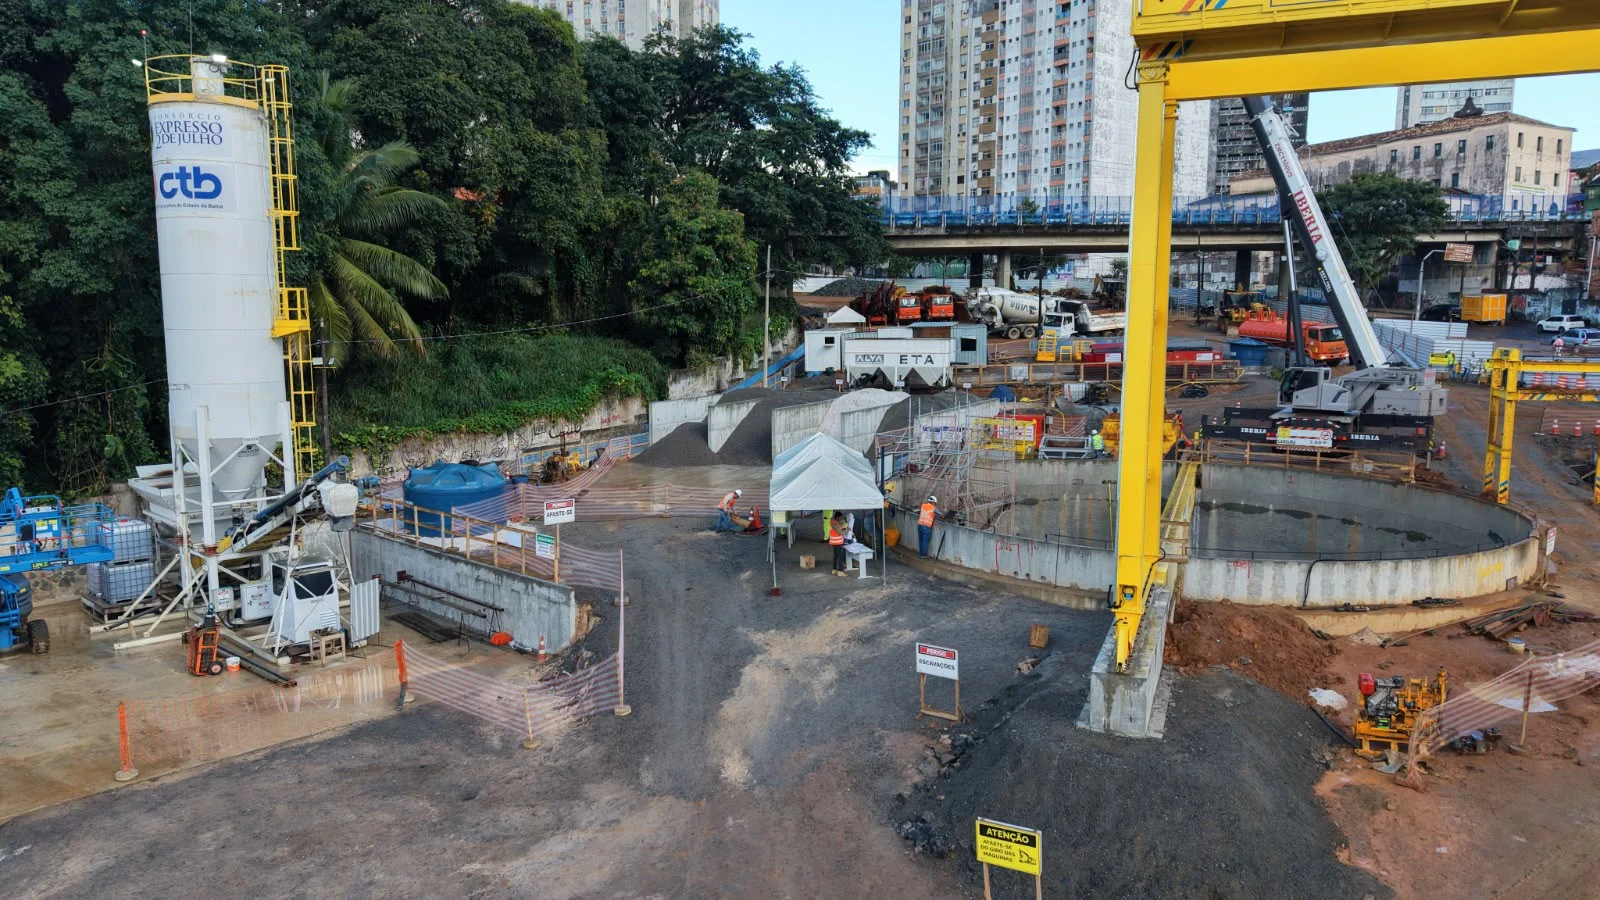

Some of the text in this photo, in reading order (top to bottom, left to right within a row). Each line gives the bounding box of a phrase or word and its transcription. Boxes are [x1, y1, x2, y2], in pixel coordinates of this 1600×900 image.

[155, 120, 223, 135] EXPRESSO
[162, 133, 176, 144] DE
[178, 133, 223, 146] JULHO
[159, 166, 223, 199] ctb
[1292, 189, 1323, 245] IBERIA
[900, 354, 934, 364] ETA
[986, 827, 1029, 843] ATENÇÃO
[983, 839, 1012, 850] AFASTE-SE
